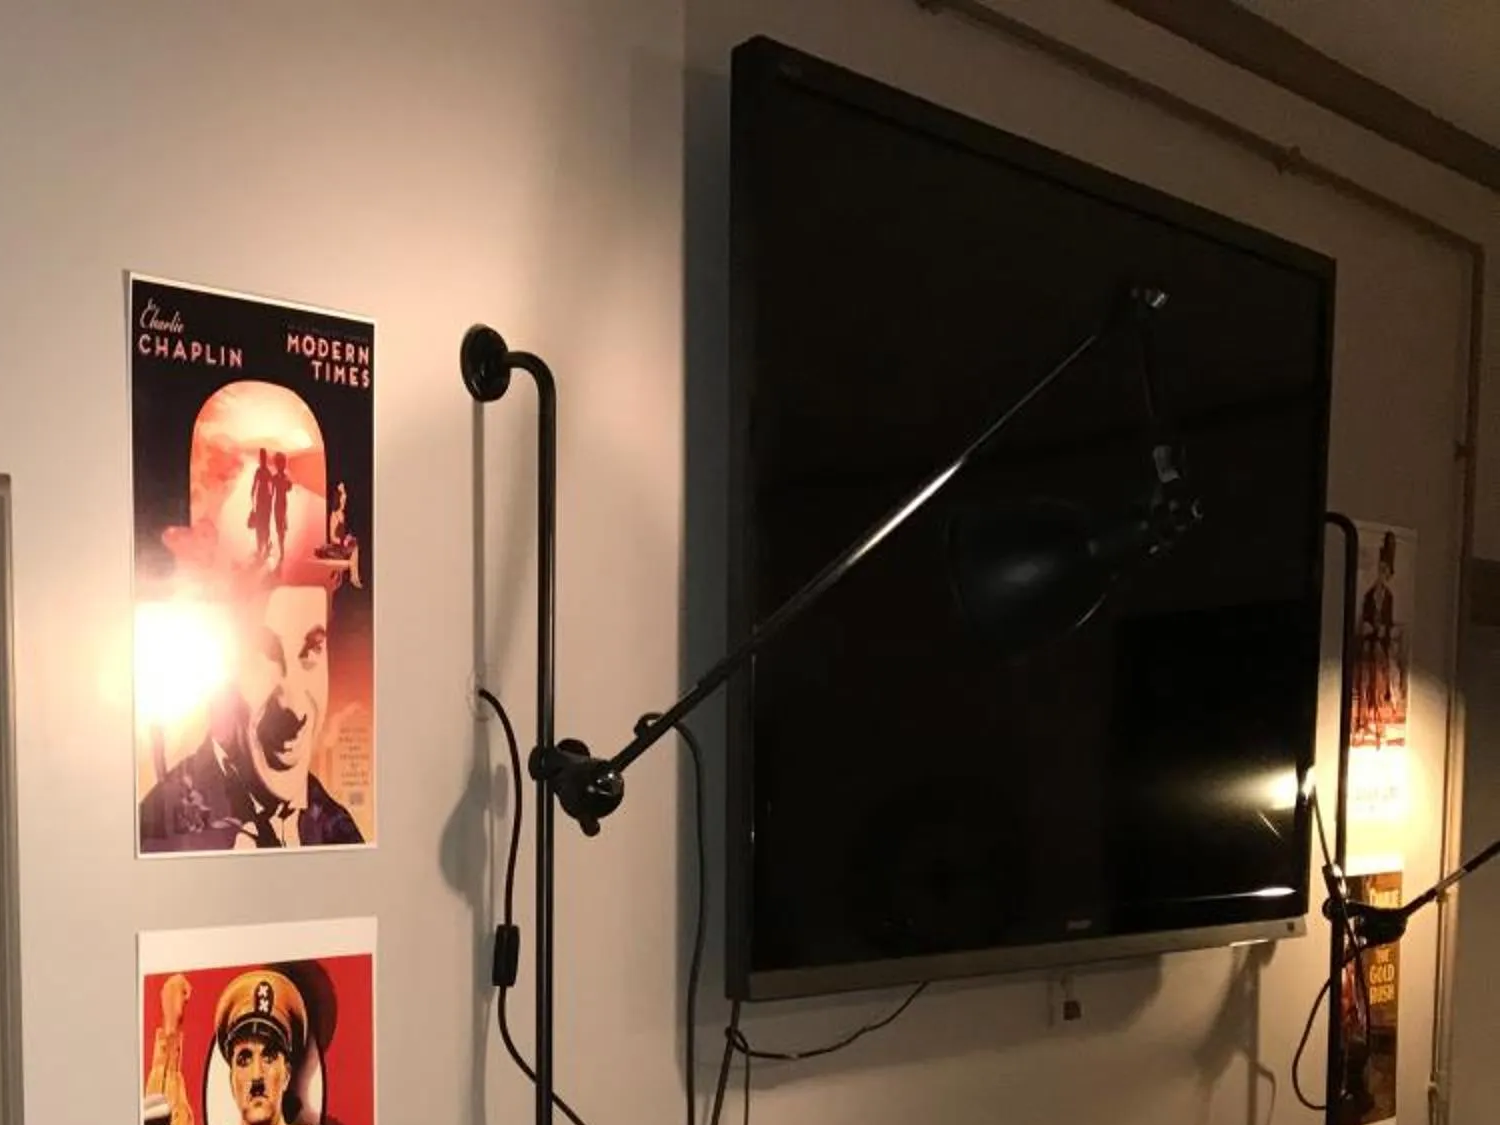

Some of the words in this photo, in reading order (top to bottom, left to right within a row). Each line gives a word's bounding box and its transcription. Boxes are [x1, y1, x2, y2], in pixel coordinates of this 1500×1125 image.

[138, 333, 243, 369] CHAPLIN
[287, 332, 369, 365] MODERN
[311, 359, 370, 389] TIMES
